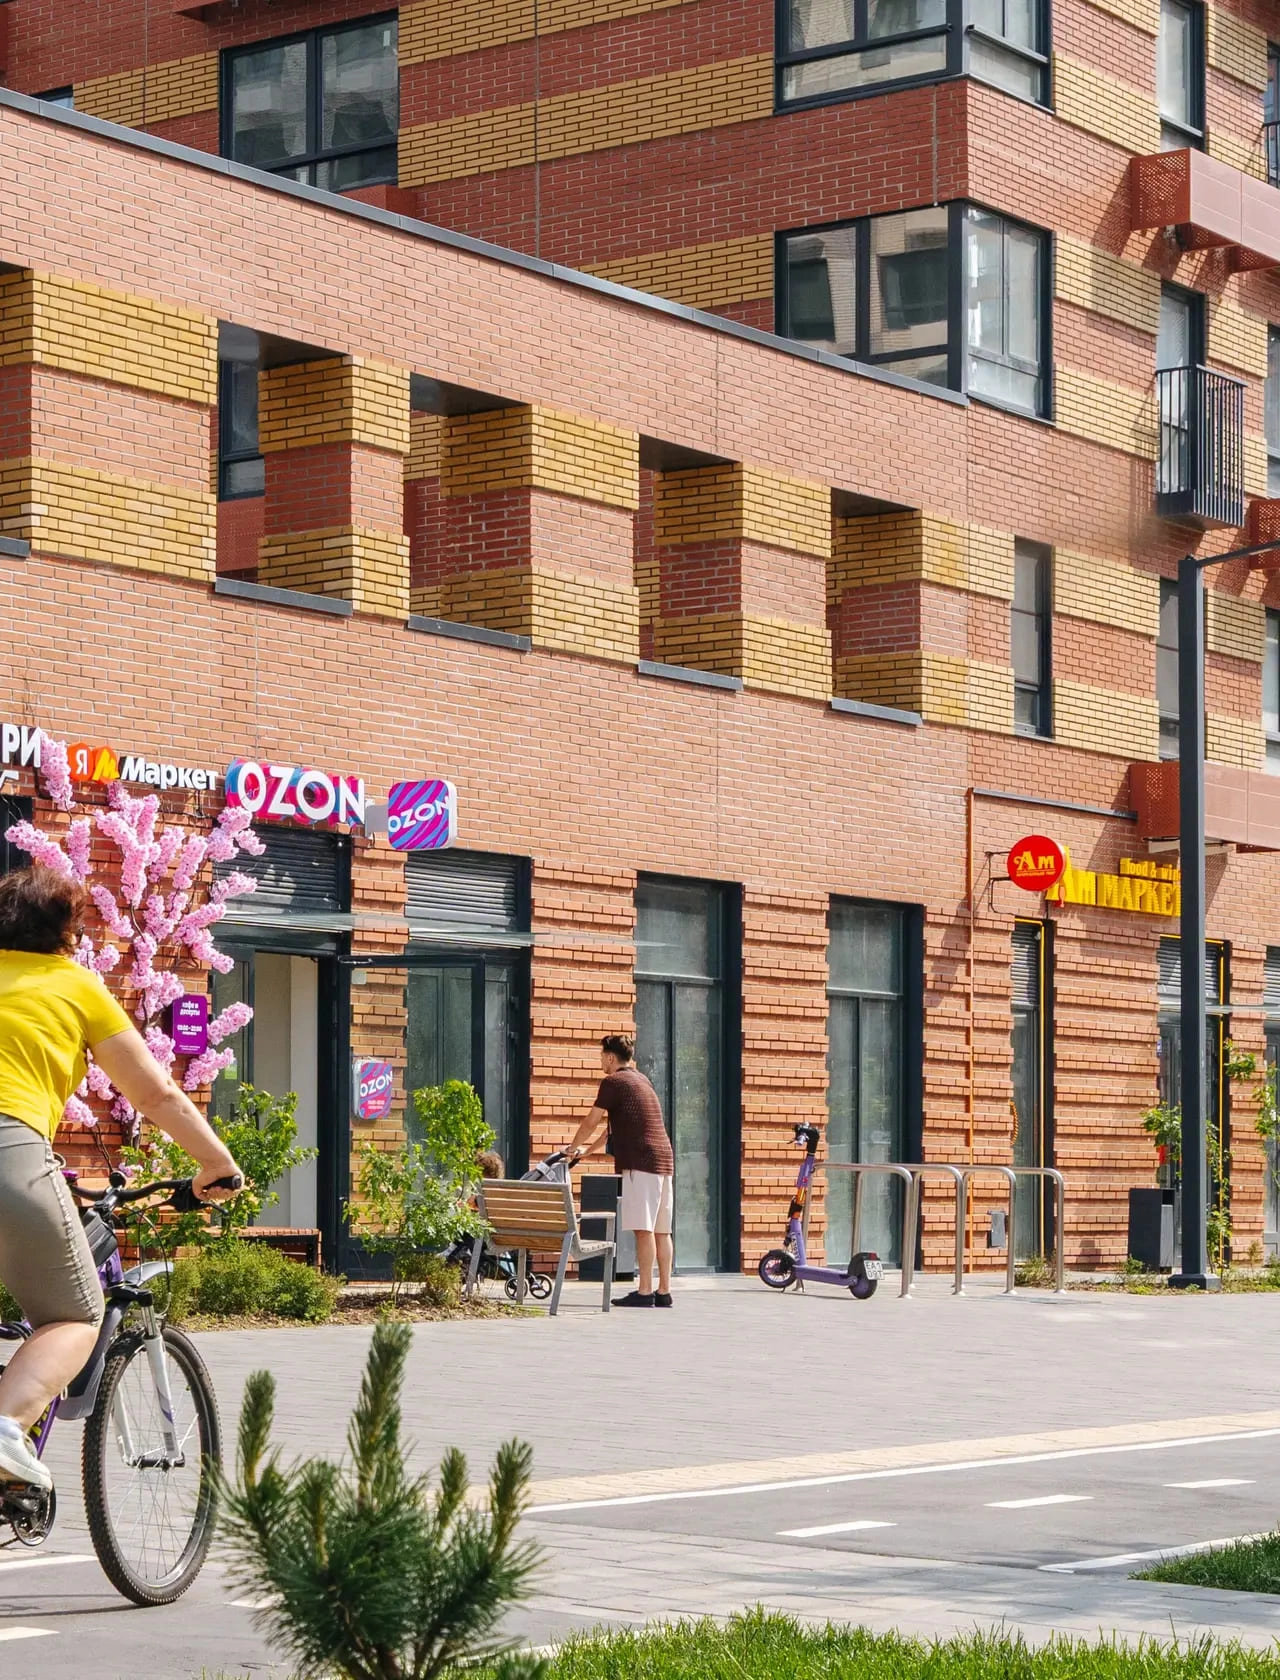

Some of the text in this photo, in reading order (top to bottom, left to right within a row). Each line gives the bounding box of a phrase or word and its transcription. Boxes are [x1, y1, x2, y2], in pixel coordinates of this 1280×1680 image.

[121, 755, 219, 791] Маркет
[237, 761, 366, 825] OZON
[387, 795, 449, 833] OZON
[1157, 863, 1181, 881] win
[360, 1070, 393, 1097] OZON
